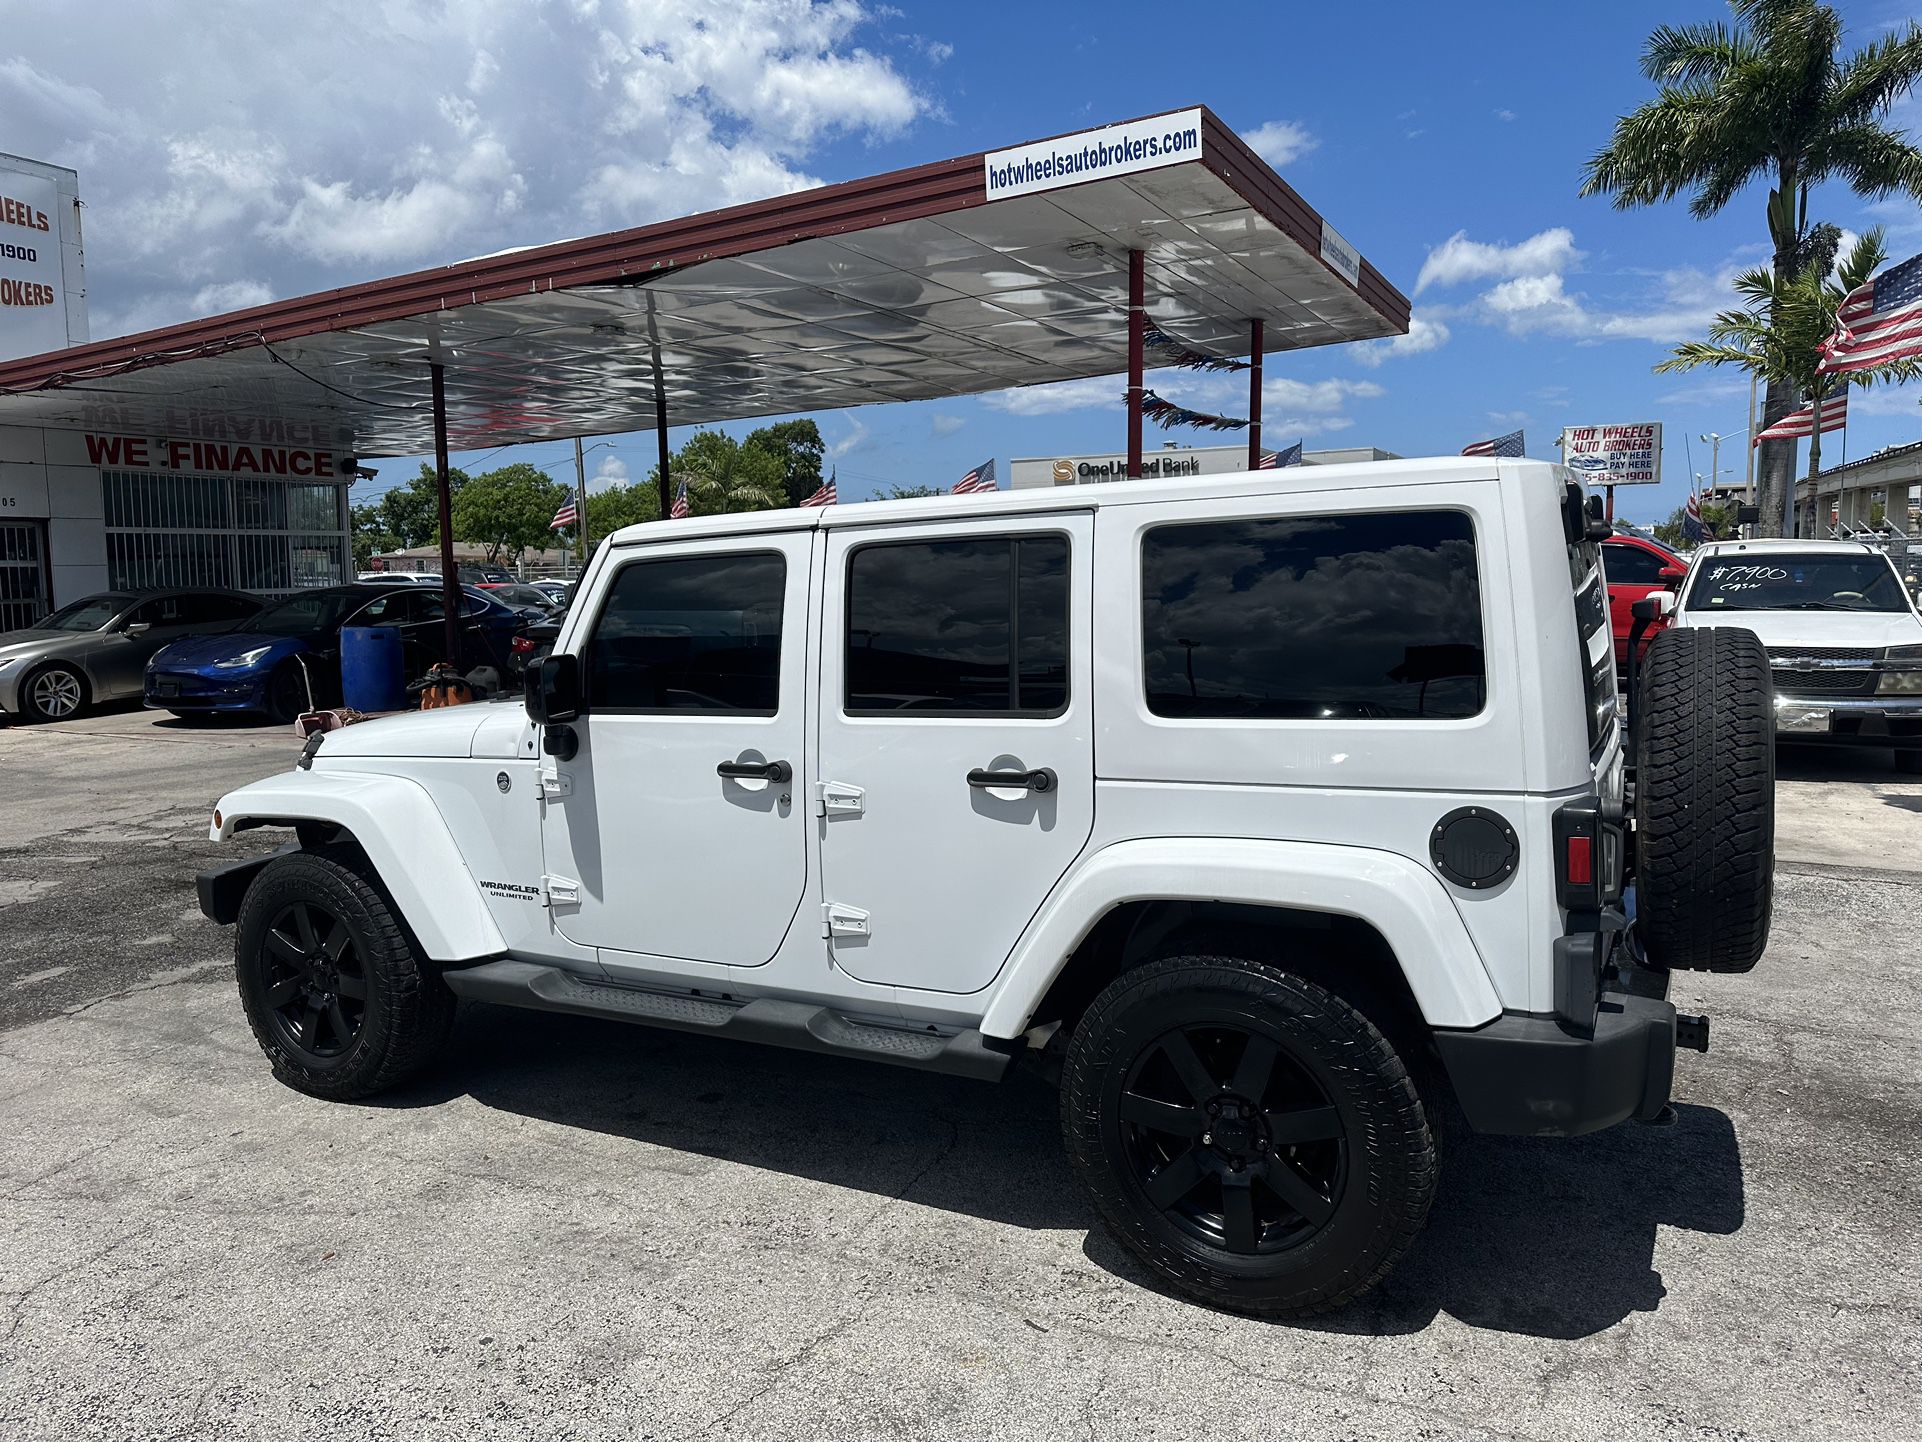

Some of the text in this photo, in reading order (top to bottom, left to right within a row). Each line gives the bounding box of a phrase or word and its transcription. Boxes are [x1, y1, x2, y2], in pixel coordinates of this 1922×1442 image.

[989, 125, 1198, 190] hotwheelsautobrokers.com
[1572, 425, 1654, 441] HOT WHEELS
[1571, 439, 1653, 453] AUTO BROKERS
[85, 434, 335, 478] WE FINANCE
[1609, 451, 1652, 460] BUY HERE
[1078, 456, 1199, 477] OneUned Bank
[1609, 460, 1652, 470] PAY HERE
[480, 880, 540, 895] WRANGLER
[490, 891, 534, 901] UNLIMITED
